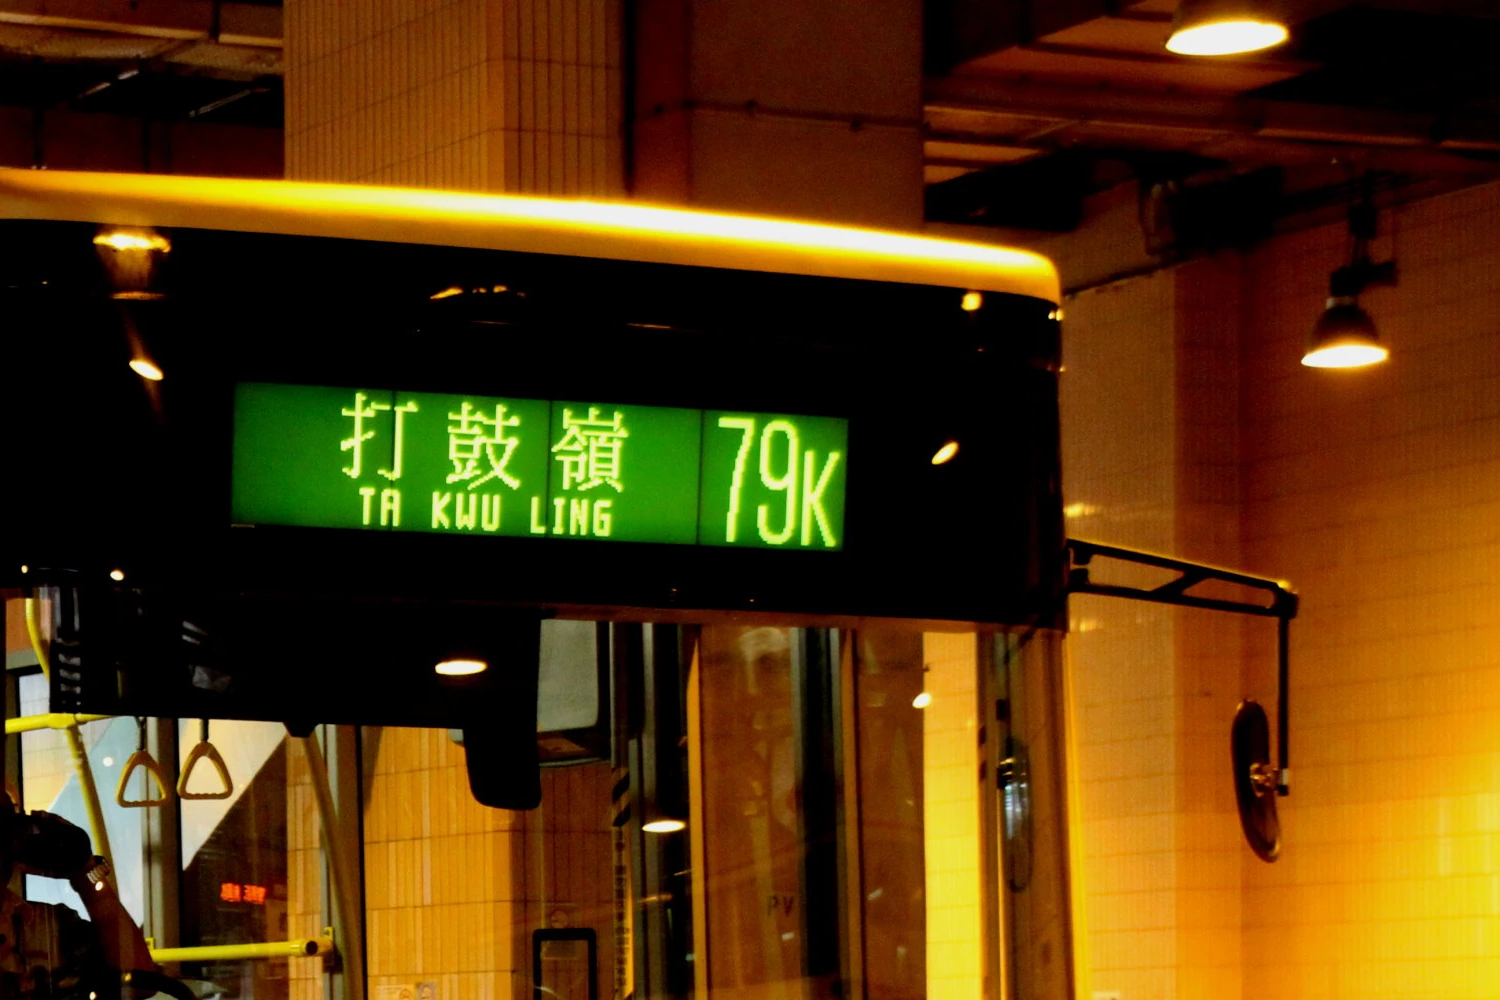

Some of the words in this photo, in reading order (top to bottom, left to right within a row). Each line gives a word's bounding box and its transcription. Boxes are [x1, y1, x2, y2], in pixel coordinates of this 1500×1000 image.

[340, 392, 628, 493] 打鼓嶺
[717, 415, 841, 548] 79K
[358, 486, 402, 528] TA
[430, 490, 502, 532] KWU
[529, 495, 613, 537] LING
